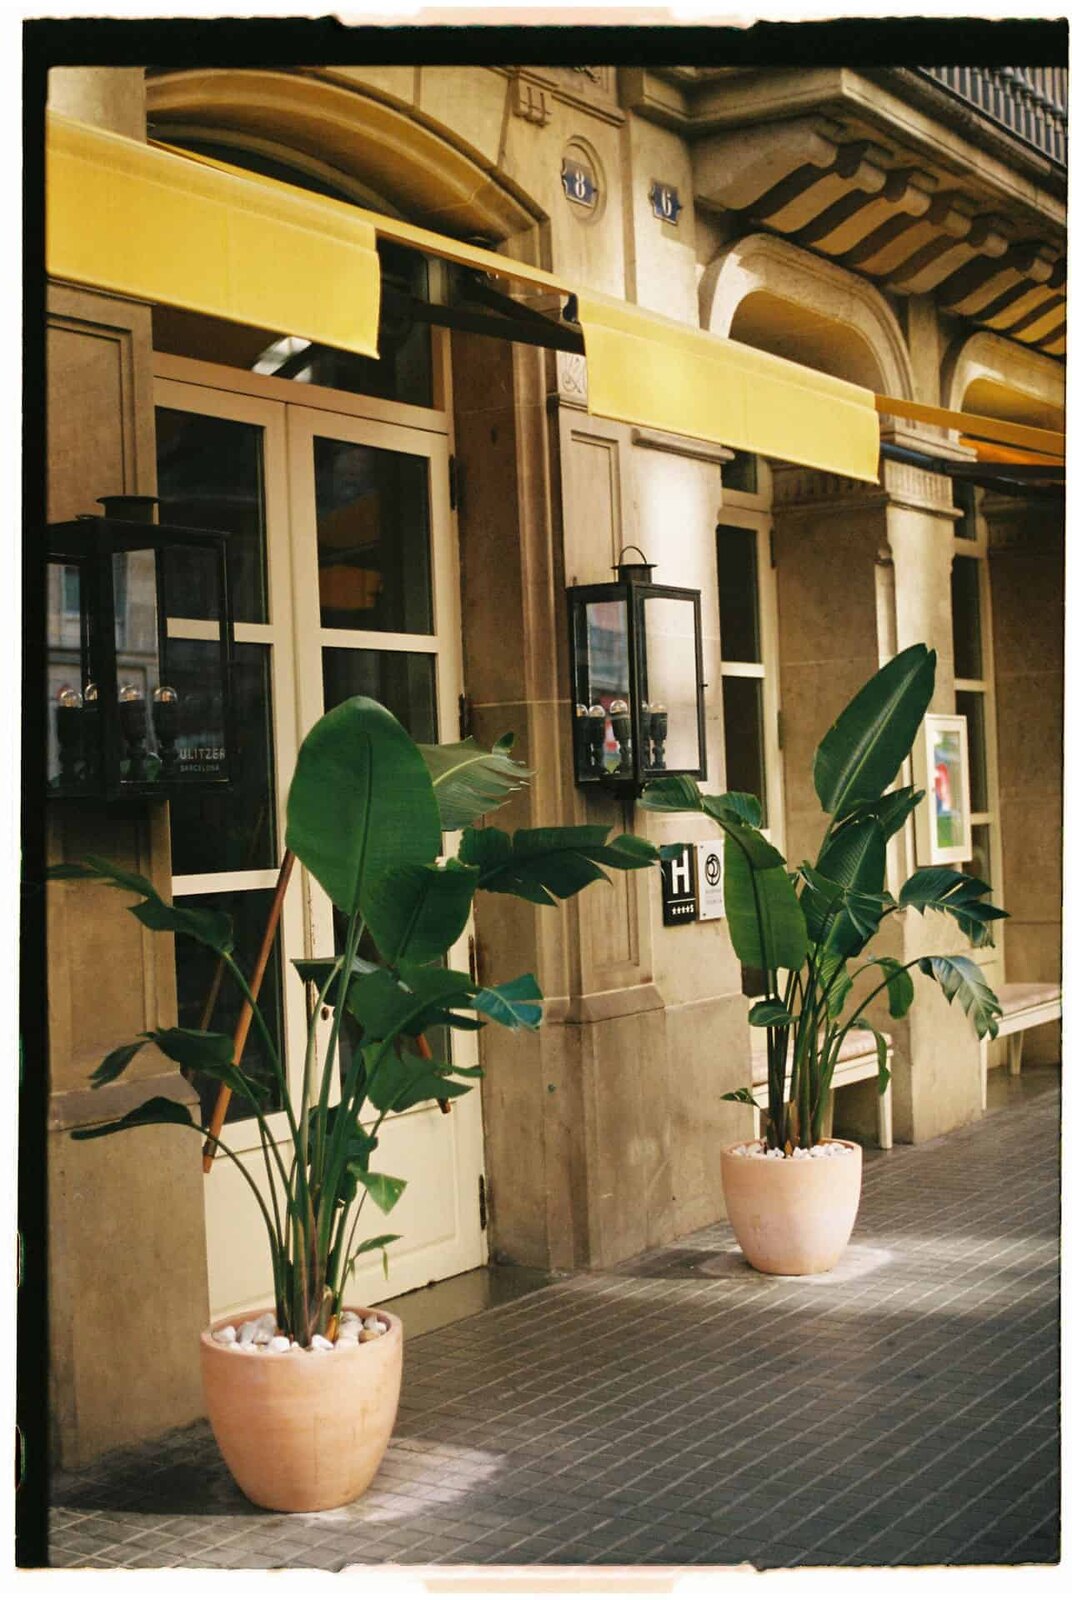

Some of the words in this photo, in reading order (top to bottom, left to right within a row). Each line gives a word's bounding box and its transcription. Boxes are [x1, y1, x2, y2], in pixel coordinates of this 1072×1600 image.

[575, 169, 585, 198] 8
[662, 189, 672, 216] 6
[179, 748, 226, 760] ULITZER
[671, 850, 690, 894] H
